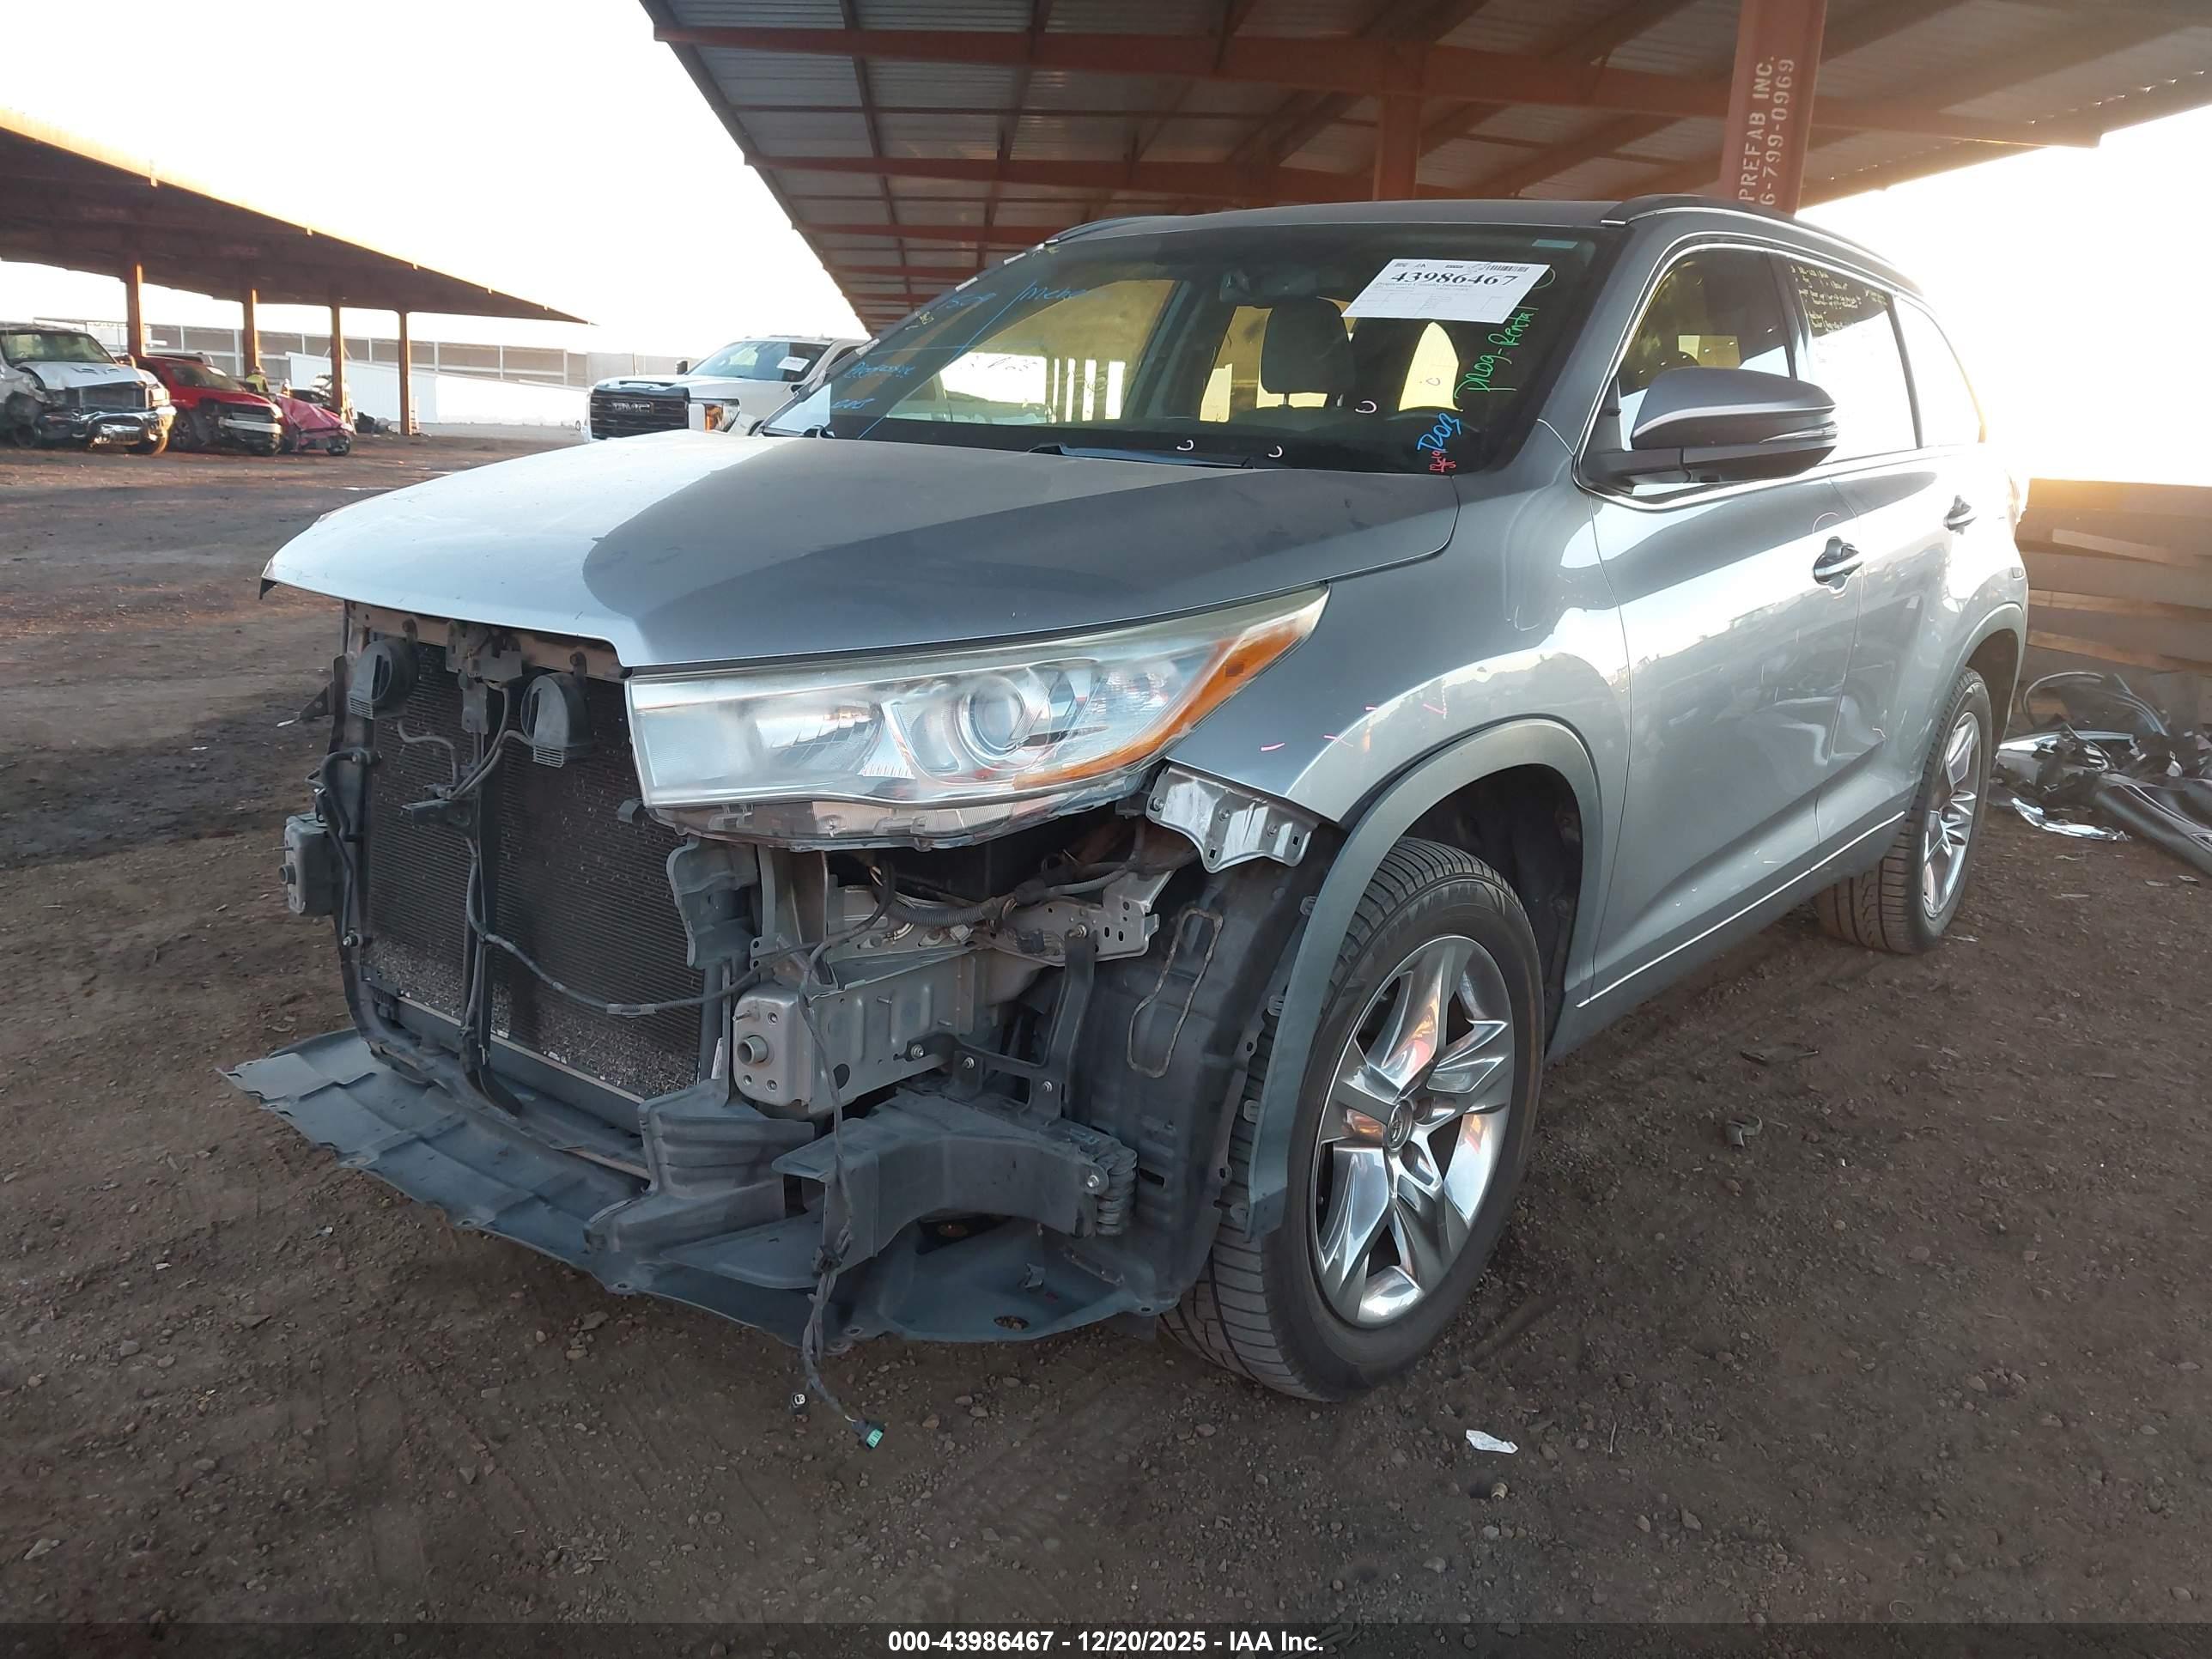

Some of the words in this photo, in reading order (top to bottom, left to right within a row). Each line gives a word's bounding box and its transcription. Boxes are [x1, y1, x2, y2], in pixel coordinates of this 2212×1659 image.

[1738, 112, 1766, 201] PREFAB
[1752, 55, 1775, 100] INC.
[1390, 270, 1518, 286] 43986467
